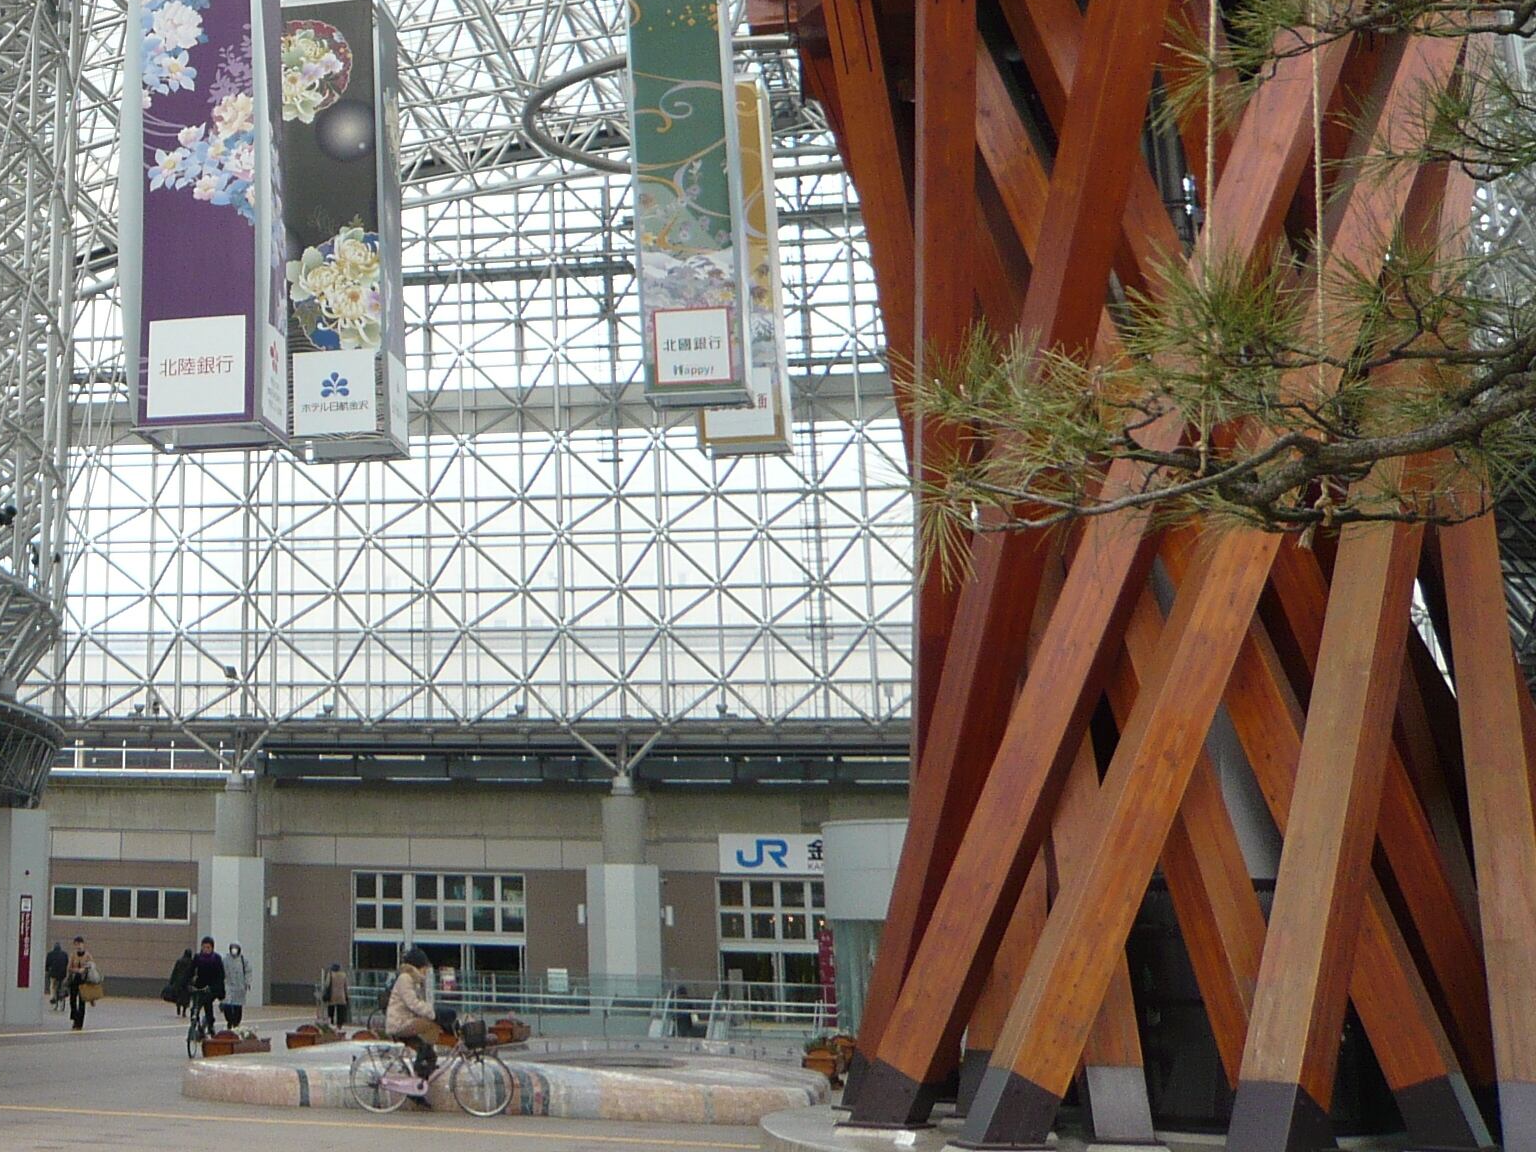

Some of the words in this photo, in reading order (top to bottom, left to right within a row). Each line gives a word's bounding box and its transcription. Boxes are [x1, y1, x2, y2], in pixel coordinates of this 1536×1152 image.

[663, 336, 721, 352] 北國銀行
[160, 355, 234, 377] 北陸銀行
[736, 839, 788, 868] JR
